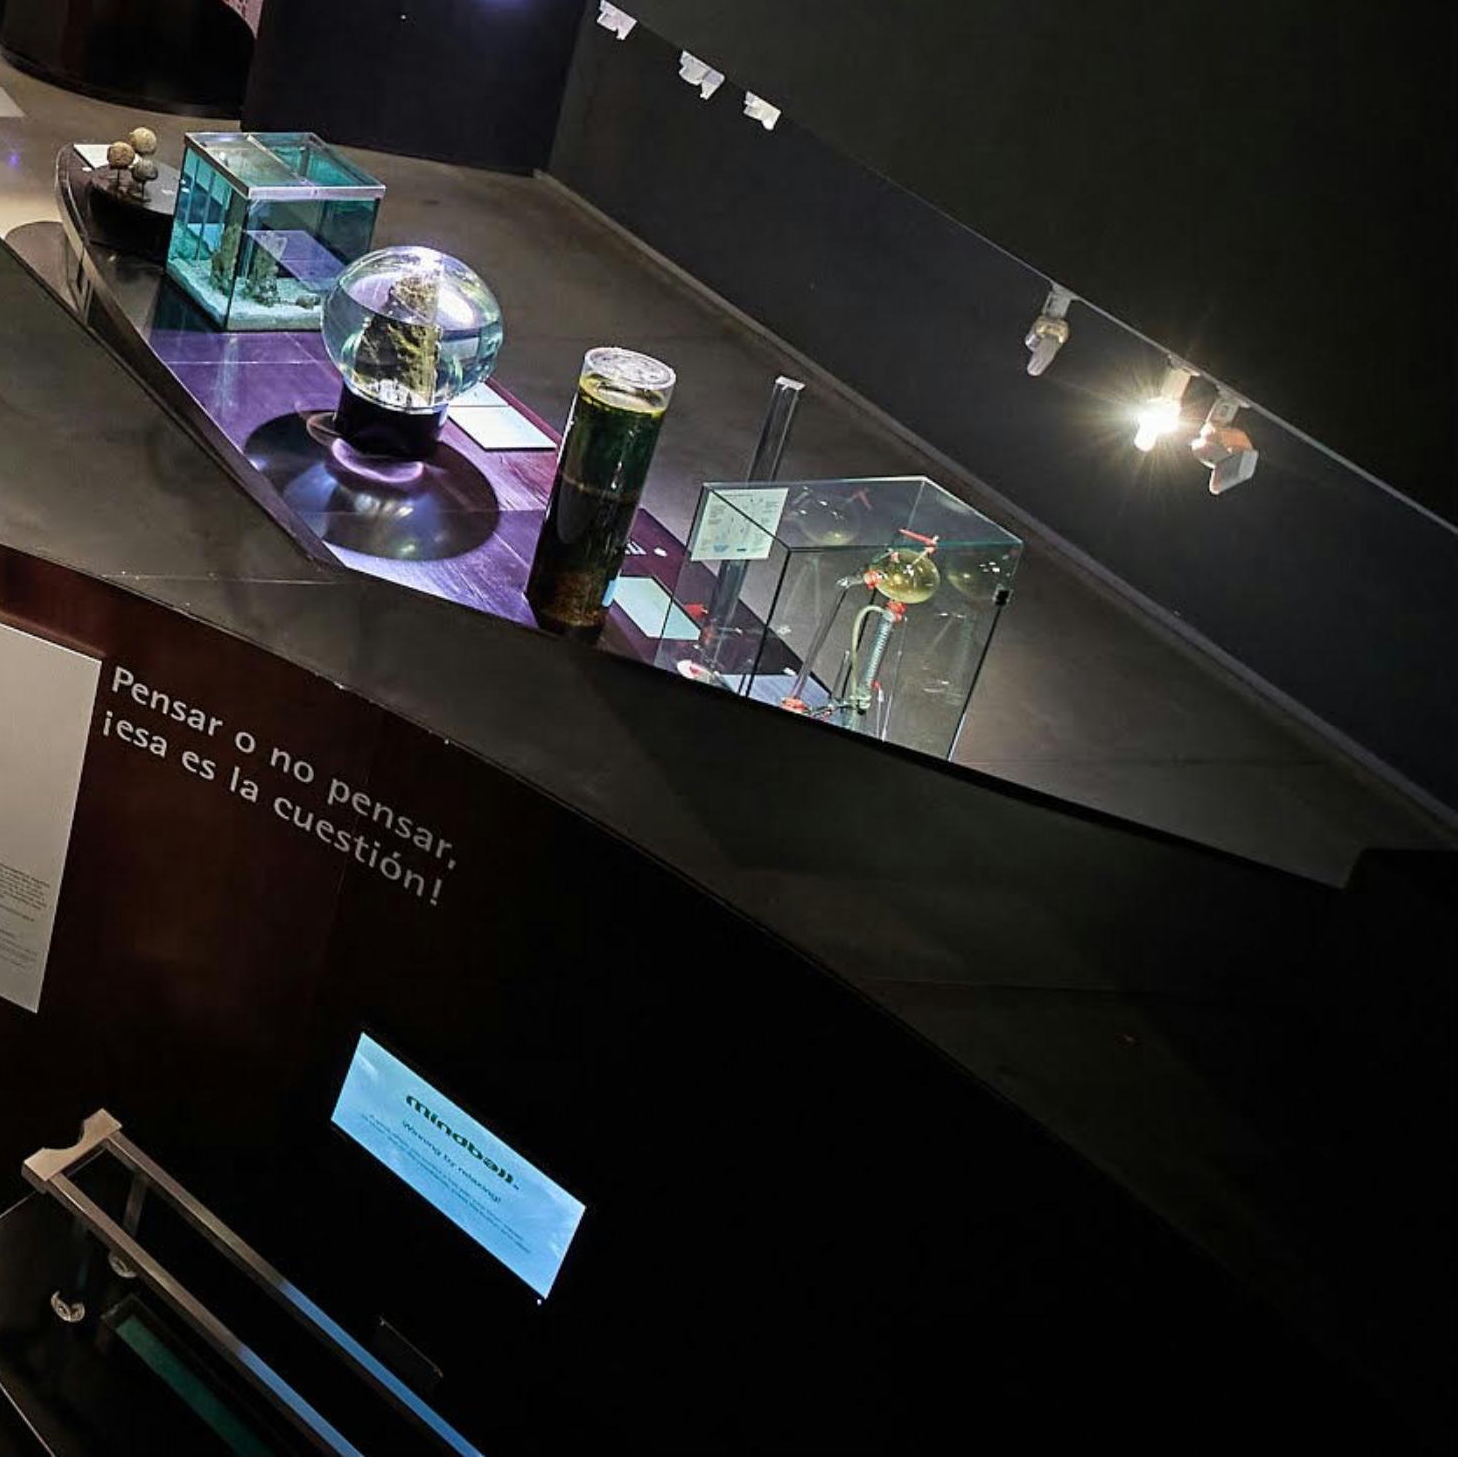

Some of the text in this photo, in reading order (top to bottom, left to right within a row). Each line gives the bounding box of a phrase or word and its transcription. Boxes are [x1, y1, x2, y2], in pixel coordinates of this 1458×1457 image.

[102, 710, 444, 906] ¡esa es la cuestión!
[111, 665, 457, 870] Pensar o no pensar,
[404, 1094, 515, 1184] mindball
